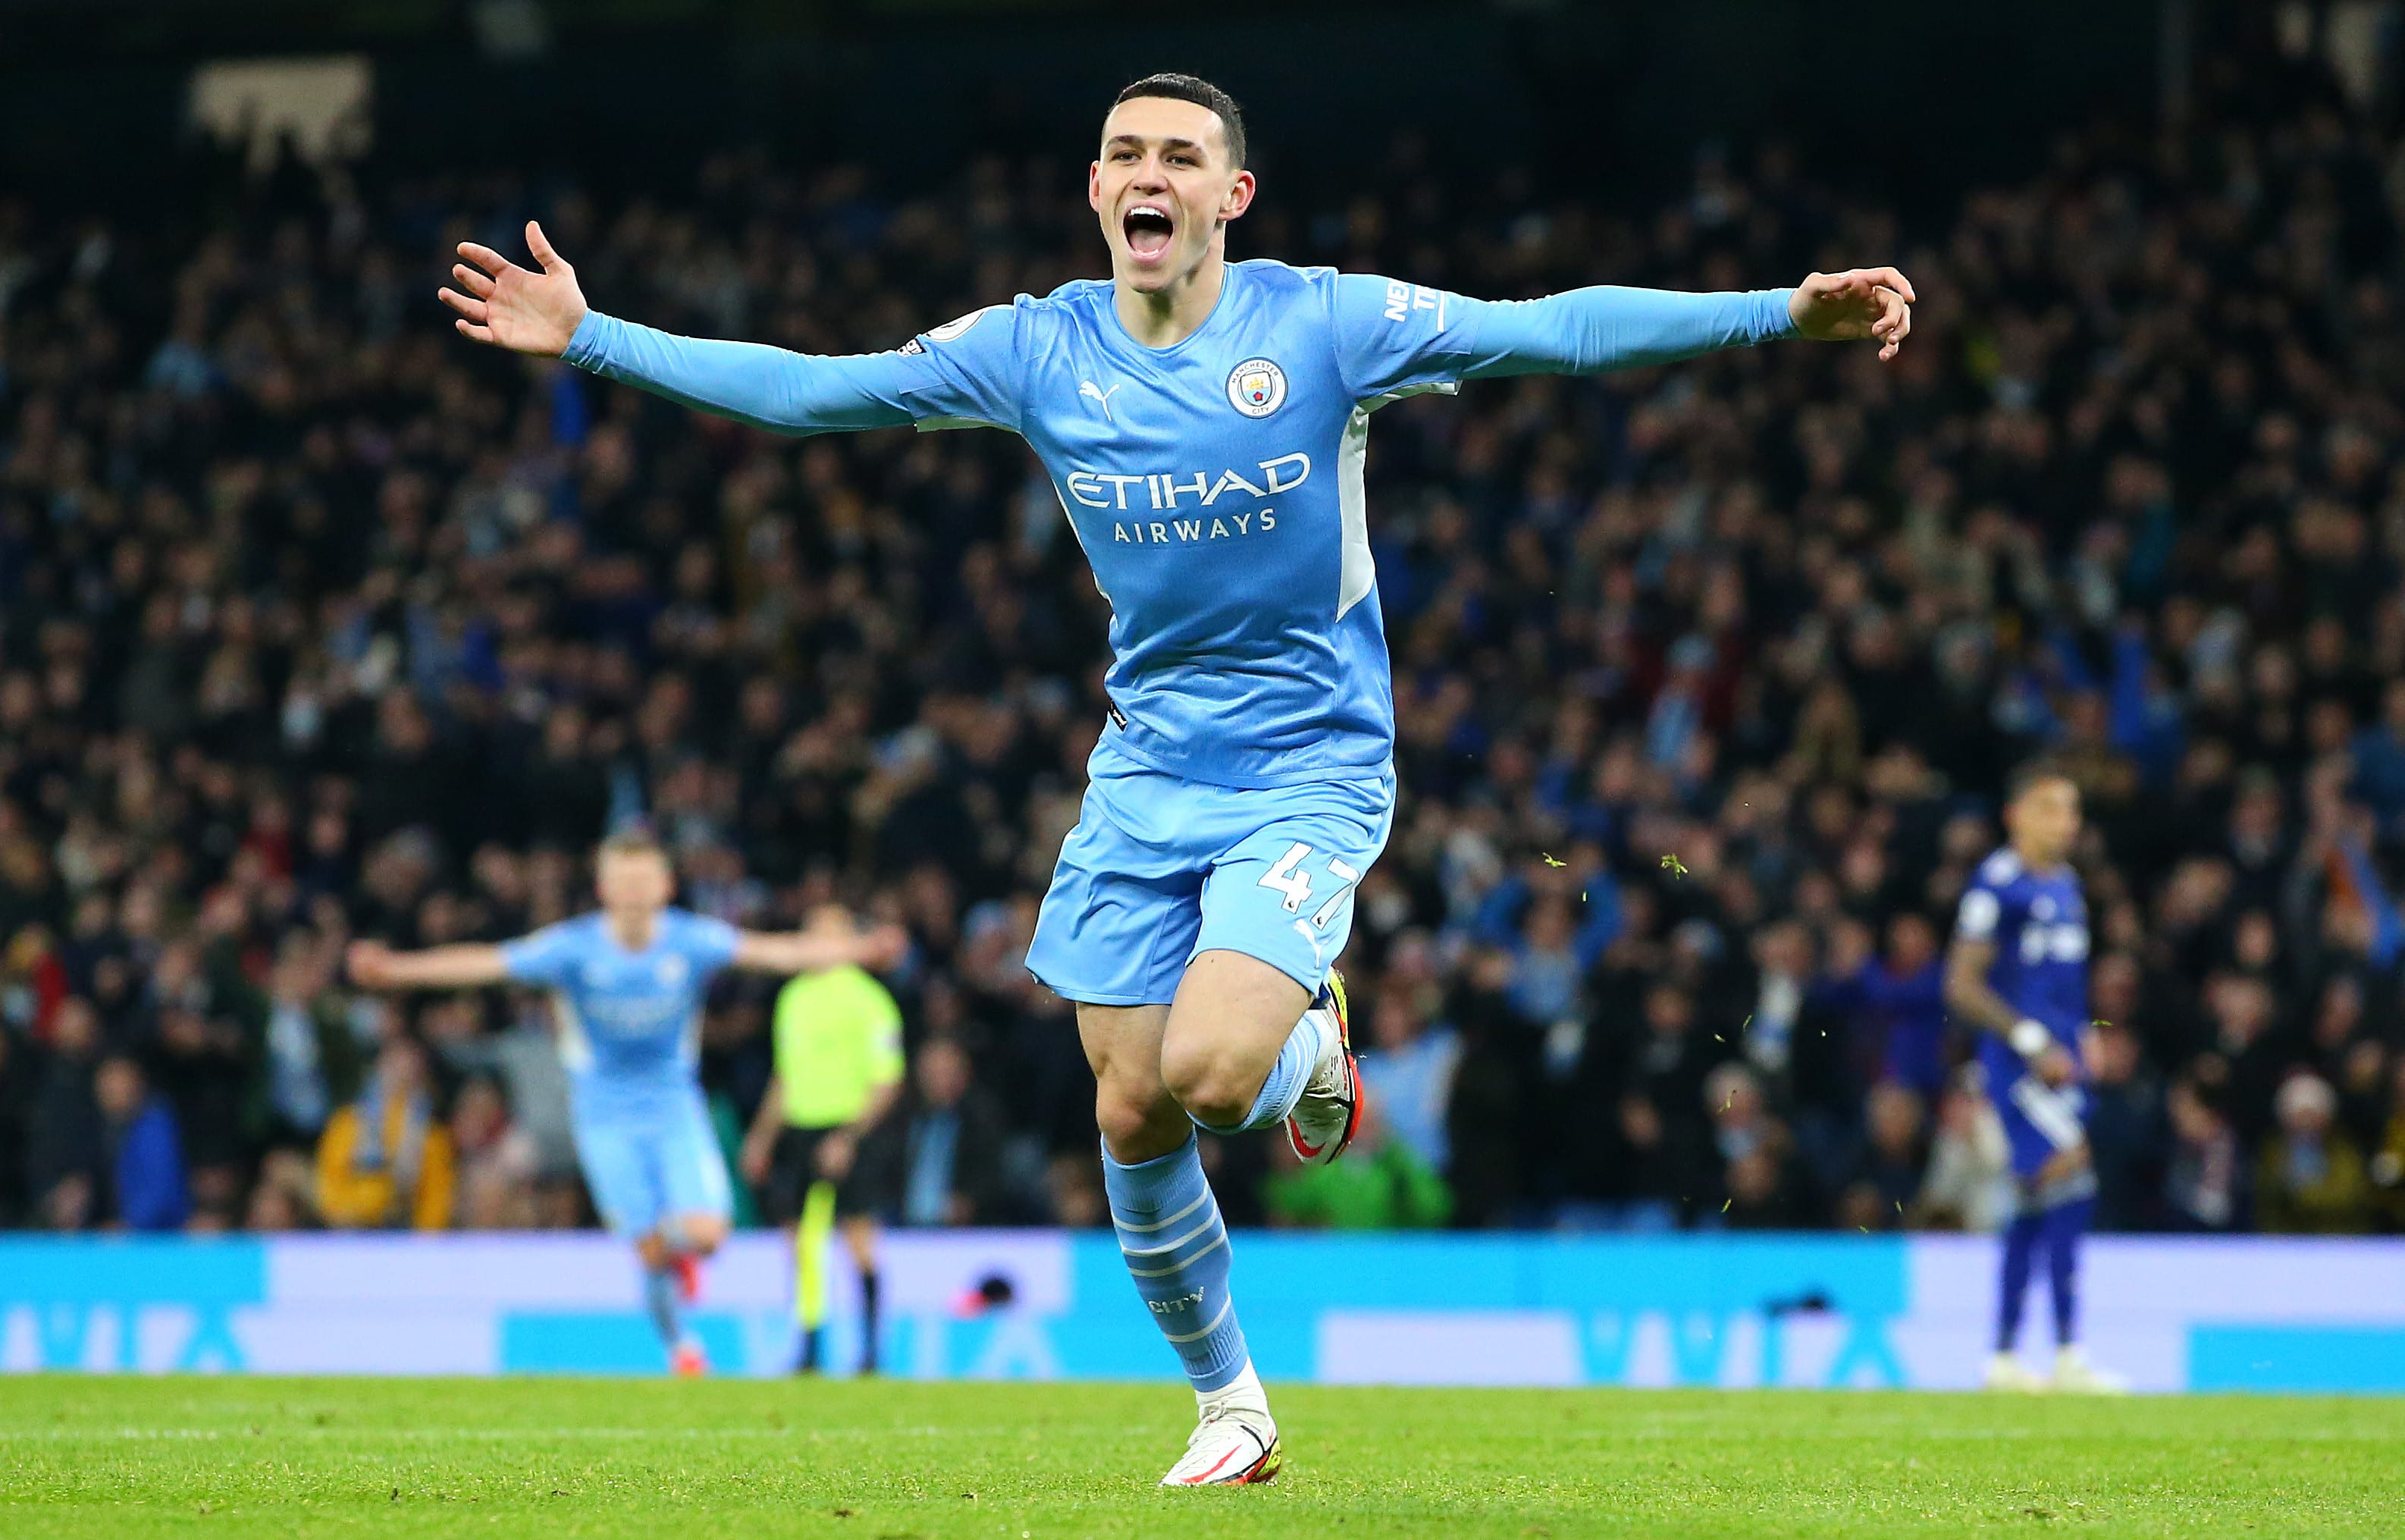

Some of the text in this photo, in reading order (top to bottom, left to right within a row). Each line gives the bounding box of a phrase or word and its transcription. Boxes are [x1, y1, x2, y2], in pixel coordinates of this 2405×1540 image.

[1231, 362, 1279, 384] MANCHESTER
[1252, 406, 1270, 415] CITY
[1066, 452, 1312, 510] ETIHAD
[1114, 508, 1277, 543] AIRWAYS
[1256, 841, 1360, 931] 47
[1148, 1286, 1205, 1313] CITY
